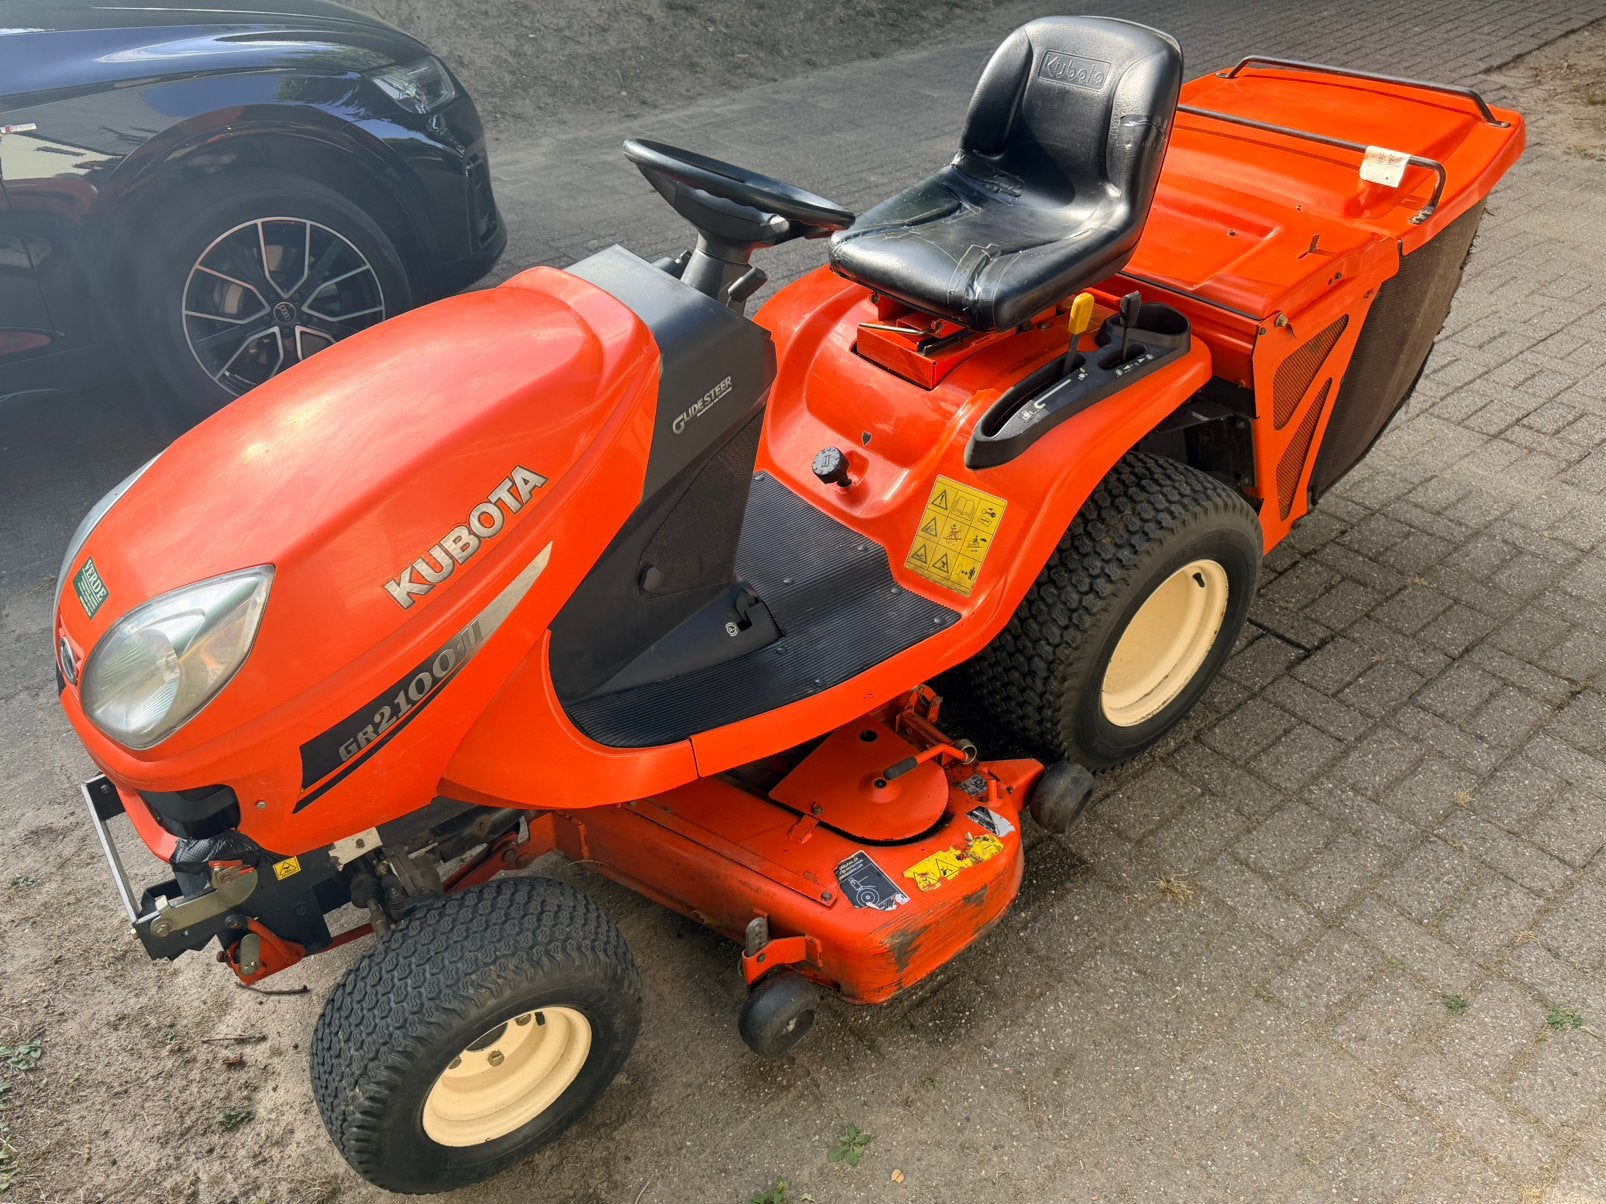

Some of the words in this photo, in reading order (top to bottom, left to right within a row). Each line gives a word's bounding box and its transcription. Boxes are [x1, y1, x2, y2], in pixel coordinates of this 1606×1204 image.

[673, 398, 704, 435] GLIDE
[703, 376, 732, 405] STEER
[384, 465, 549, 610] KUBOTA
[85, 559, 107, 602] VERDE
